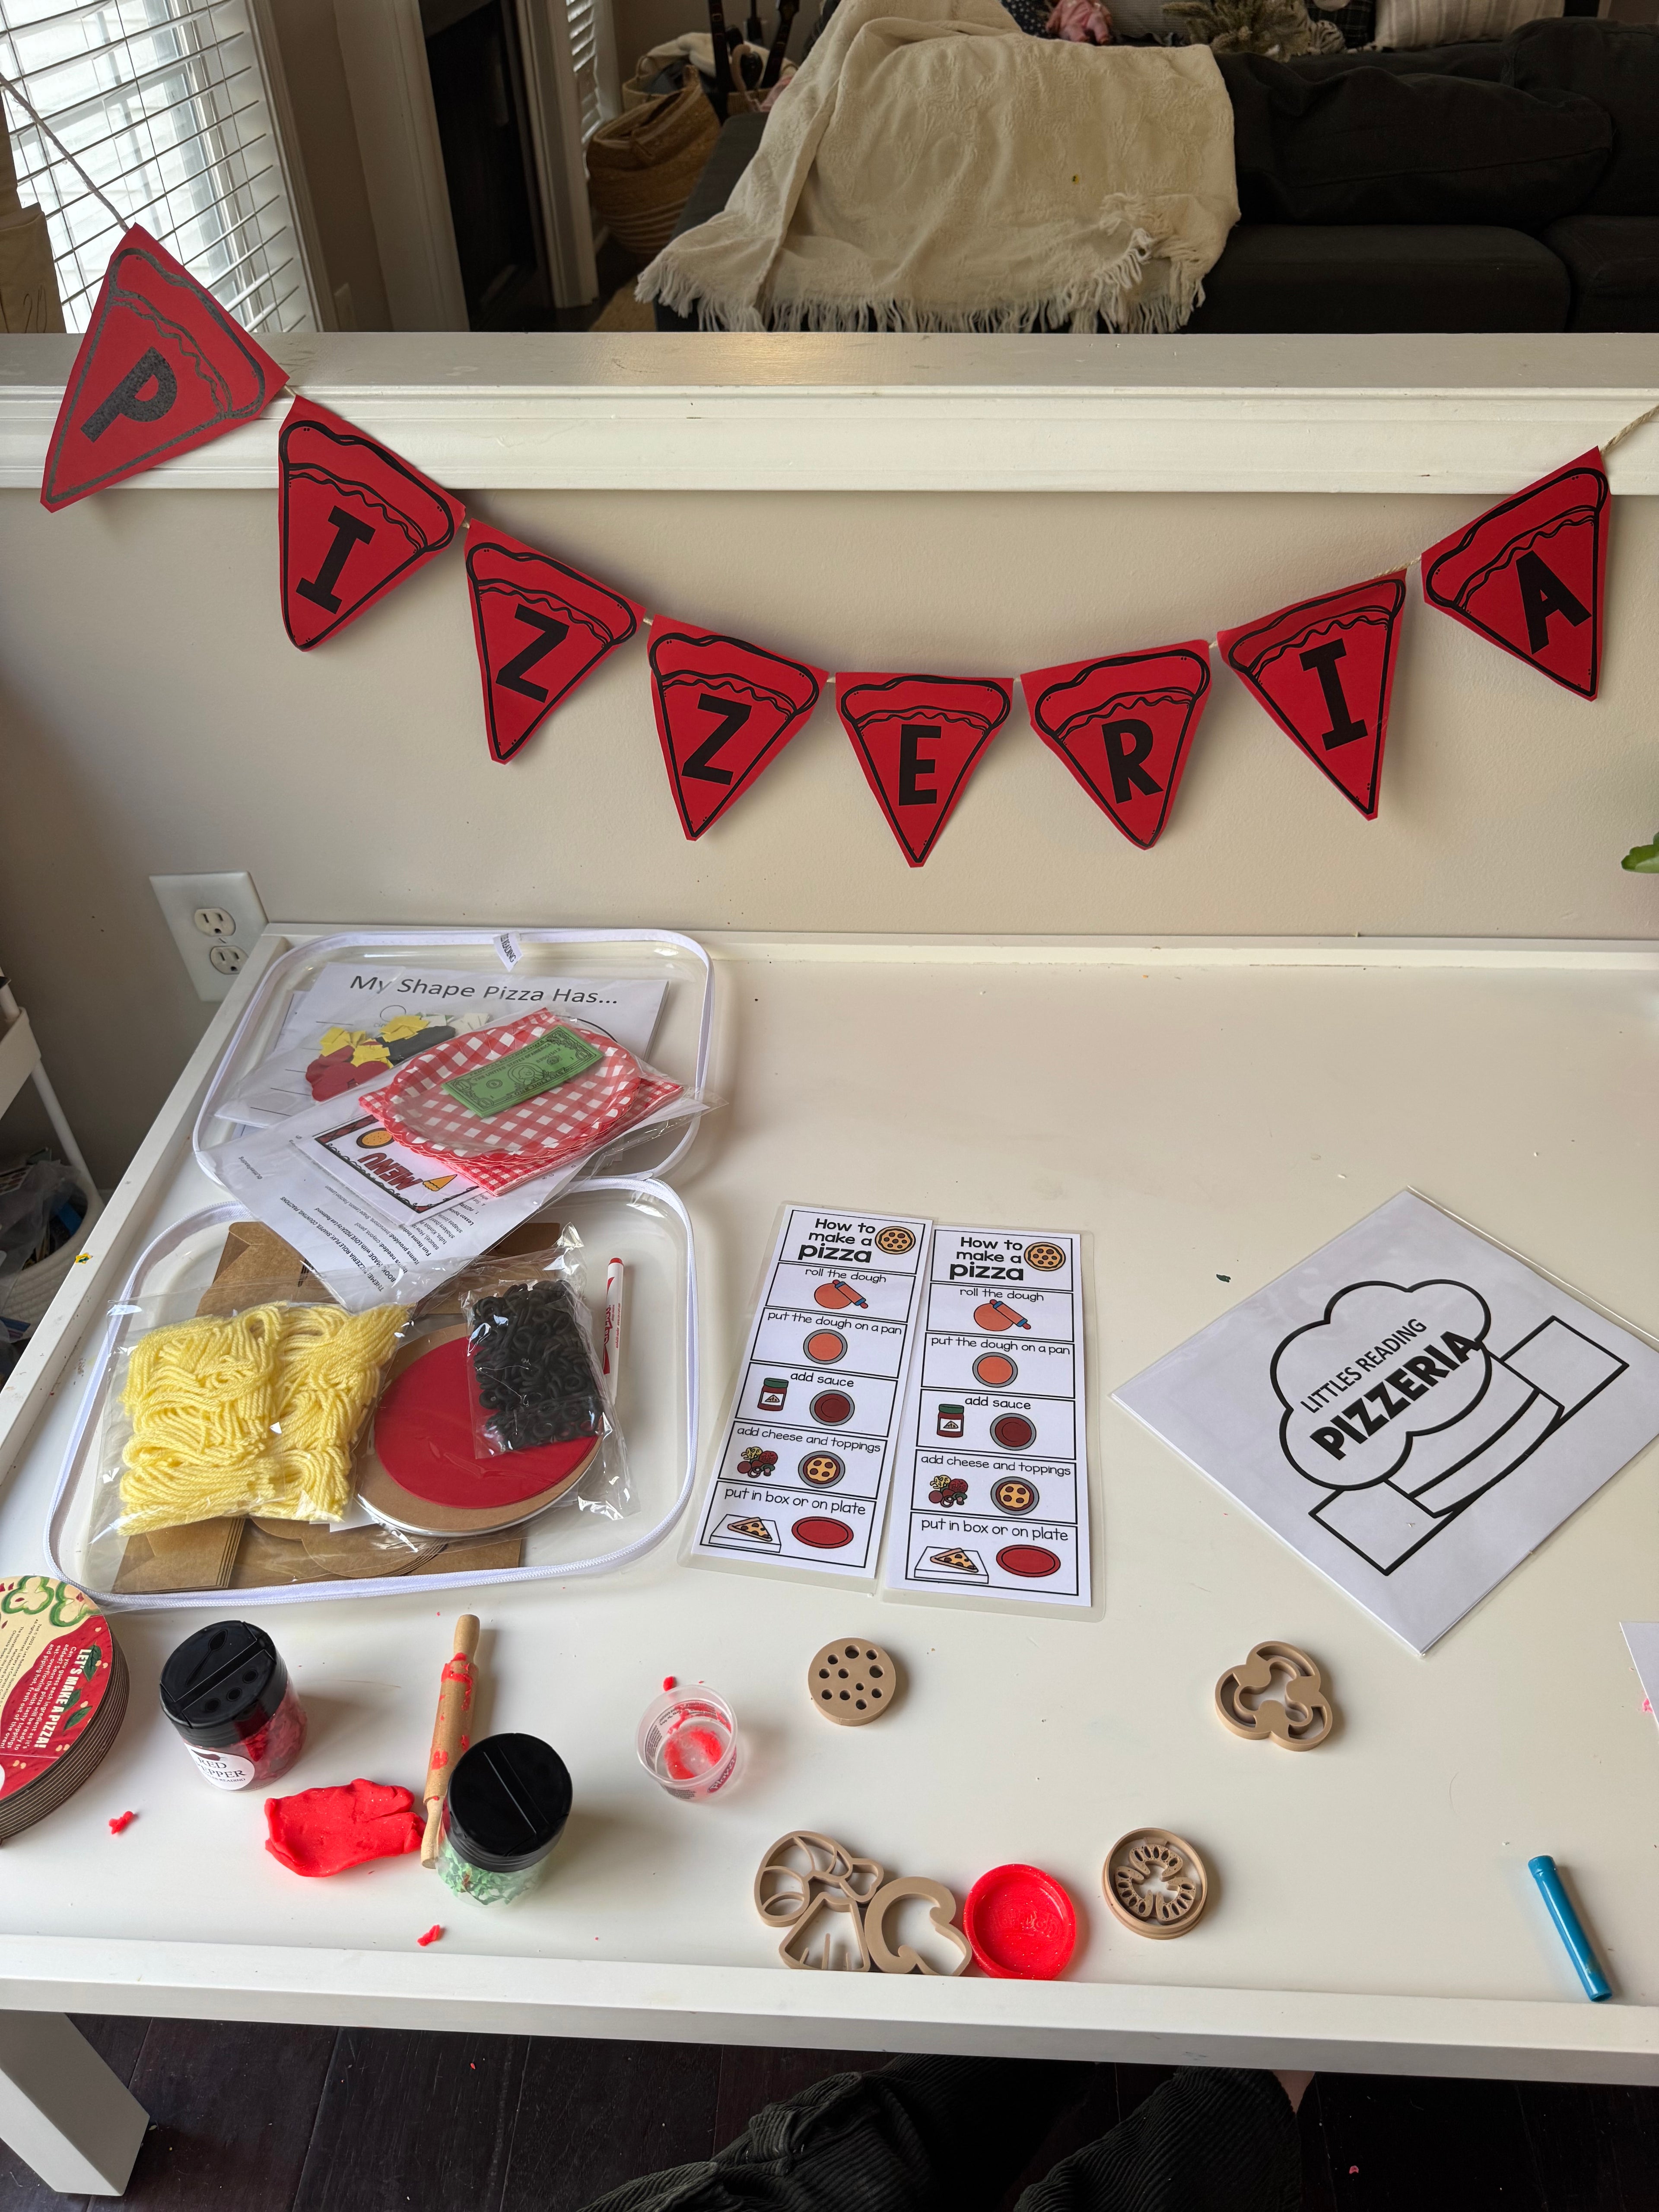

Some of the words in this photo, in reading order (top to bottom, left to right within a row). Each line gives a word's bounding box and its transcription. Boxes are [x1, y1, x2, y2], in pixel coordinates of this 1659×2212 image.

[350, 976, 393, 994] My
[397, 979, 475, 998] Shape
[483, 986, 544, 1001] Pizza
[552, 988, 618, 1004] Has...
[358, 1153, 423, 1191] MENU
[280, 1197, 300, 1211] FRACTIONS
[354, 1222, 368, 1231] pencil
[448, 1220, 463, 1233] shapes
[460, 1214, 474, 1226] Lesson
[815, 1218, 852, 1231] How
[858, 1223, 875, 1233] to
[365, 1230, 381, 1243] crayons,
[415, 1227, 426, 1236] How
[439, 1224, 455, 1239] shakers
[350, 1235, 363, 1246] LOVE
[389, 1233, 409, 1251] provided:
[411, 1235, 423, 1248] Items
[424, 1234, 439, 1250] sauce),
[437, 1233, 447, 1245] tubs,
[808, 1232, 855, 1244] make
[861, 1238, 872, 1246] a
[961, 1237, 998, 1249] How
[1004, 1239, 1023, 1251] to
[339, 1243, 351, 1254] ROLE
[361, 1244, 371, 1254] with
[379, 1243, 396, 1260] needed:
[422, 1246, 431, 1256] Fun
[798, 1243, 872, 1263] pizza
[350, 1253, 367, 1274] PIZZERIA
[368, 1252, 383, 1267] MADE
[407, 1251, 420, 1265] Items
[957, 1251, 1004, 1262] make
[827, 1270, 846, 1279] the
[851, 1272, 886, 1283] dough
[950, 1262, 1023, 1281] pizza
[367, 1273, 384, 1292] THEME:
[982, 1289, 1003, 1298] the
[1007, 1291, 1044, 1302] dough
[768, 1312, 789, 1320] put
[791, 1313, 812, 1323] the
[816, 1316, 851, 1329] dough
[881, 1326, 902, 1335] pan
[931, 1336, 953, 1346] put
[956, 1337, 976, 1347] the
[981, 1339, 1017, 1351] dough
[1049, 1347, 1070, 1355] pan
[1300, 1367, 1362, 1413] LITTLES
[1355, 1319, 1427, 1372] READING
[791, 1372, 814, 1382] add
[817, 1376, 854, 1387] sauce
[965, 1396, 988, 1406] add
[993, 1400, 1031, 1409] sauce
[1309, 1331, 1481, 1461] PIZZERIA
[737, 1427, 760, 1437] add
[762, 1429, 803, 1442] cheese
[806, 1437, 828, 1446] and
[831, 1437, 880, 1453] toppings
[921, 1455, 943, 1464] add
[947, 1456, 989, 1468] cheese
[993, 1462, 1015, 1470] and
[1019, 1462, 1071, 1477] toppings
[725, 1488, 749, 1500] put
[752, 1491, 762, 1501] in
[766, 1491, 789, 1505] box
[793, 1497, 808, 1507] or
[812, 1500, 827, 1510] on
[831, 1500, 865, 1515] plate
[922, 1518, 946, 1530] put
[949, 1520, 959, 1531] in
[963, 1520, 988, 1533] box
[992, 1526, 1008, 1535] or
[1012, 1528, 1028, 1537] on
[1032, 1526, 1068, 1541] plate
[57, 1644, 69, 1664] added?
[67, 1646, 76, 1657] Can
[36, 1656, 48, 1673] piping
[70, 1649, 91, 1674] LET'S
[49, 1665, 60, 1679] Soon
[54, 1670, 64, 1685] guess
[30, 1674, 41, 1685] hot,
[44, 1681, 52, 1690] the
[23, 1687, 34, 1702] fresh
[47, 1687, 56, 1700] each
[56, 1676, 78, 1704] MAKE
[29, 1693, 38, 1705] with
[37, 1691, 46, 1705] pizza
[20, 1707, 32, 1721] tasty
[31, 1707, 39, 1716] will
[32, 1701, 51, 1731] ingredient
[8, 1722, 17, 1731] the
[35, 1715, 60, 1748] PIZZA!
[7, 1723, 24, 1748] toppings
[17, 1726, 29, 1742] ready
[22, 1740, 32, 1749] it's
[198, 1757, 226, 1768] RED
